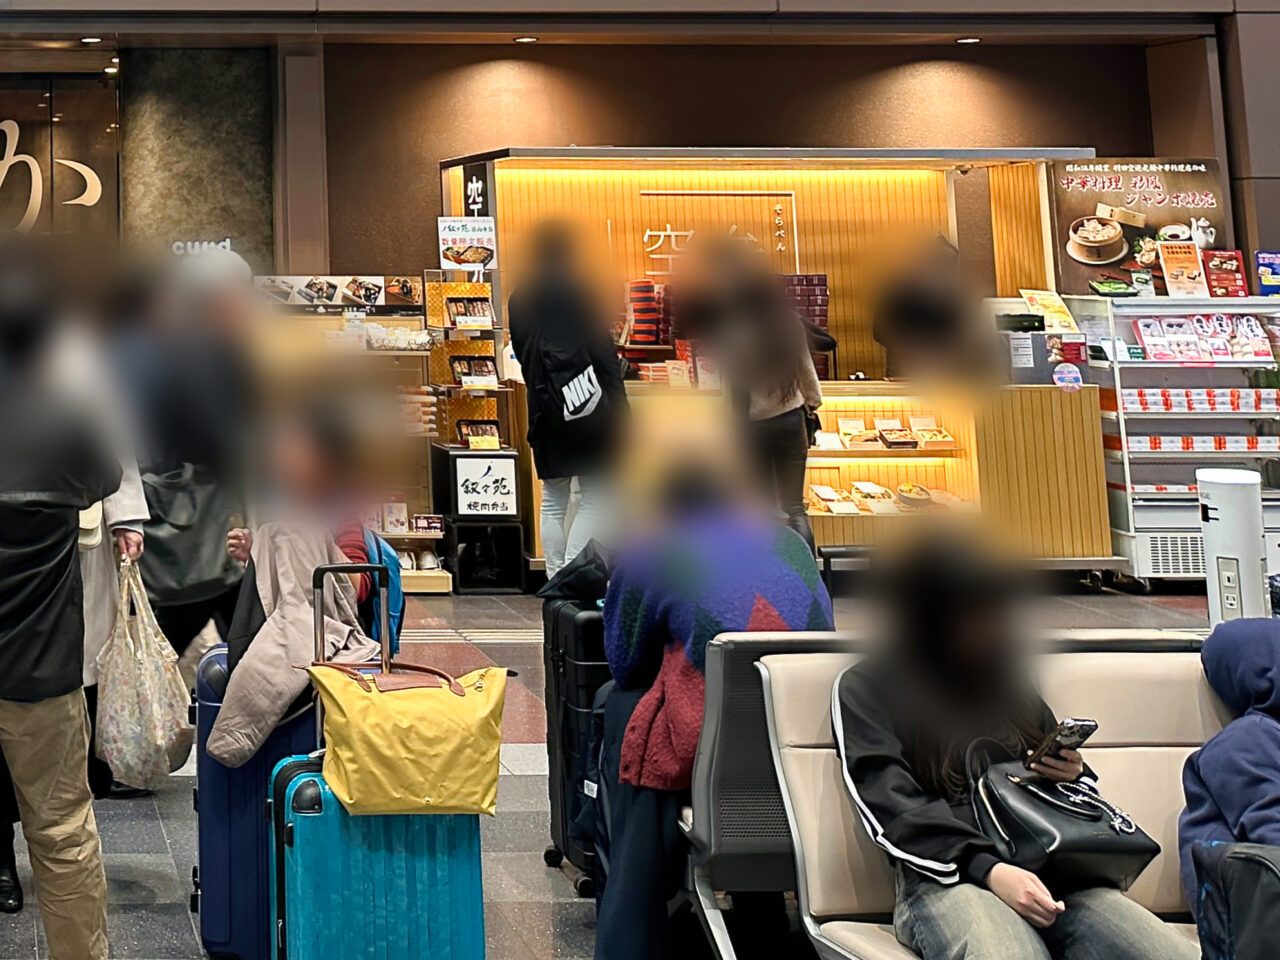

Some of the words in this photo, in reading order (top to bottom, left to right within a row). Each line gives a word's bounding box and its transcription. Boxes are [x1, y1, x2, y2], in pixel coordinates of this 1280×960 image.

[1060, 175, 1122, 191] 中華料理
[773, 203, 787, 252] そらべん
